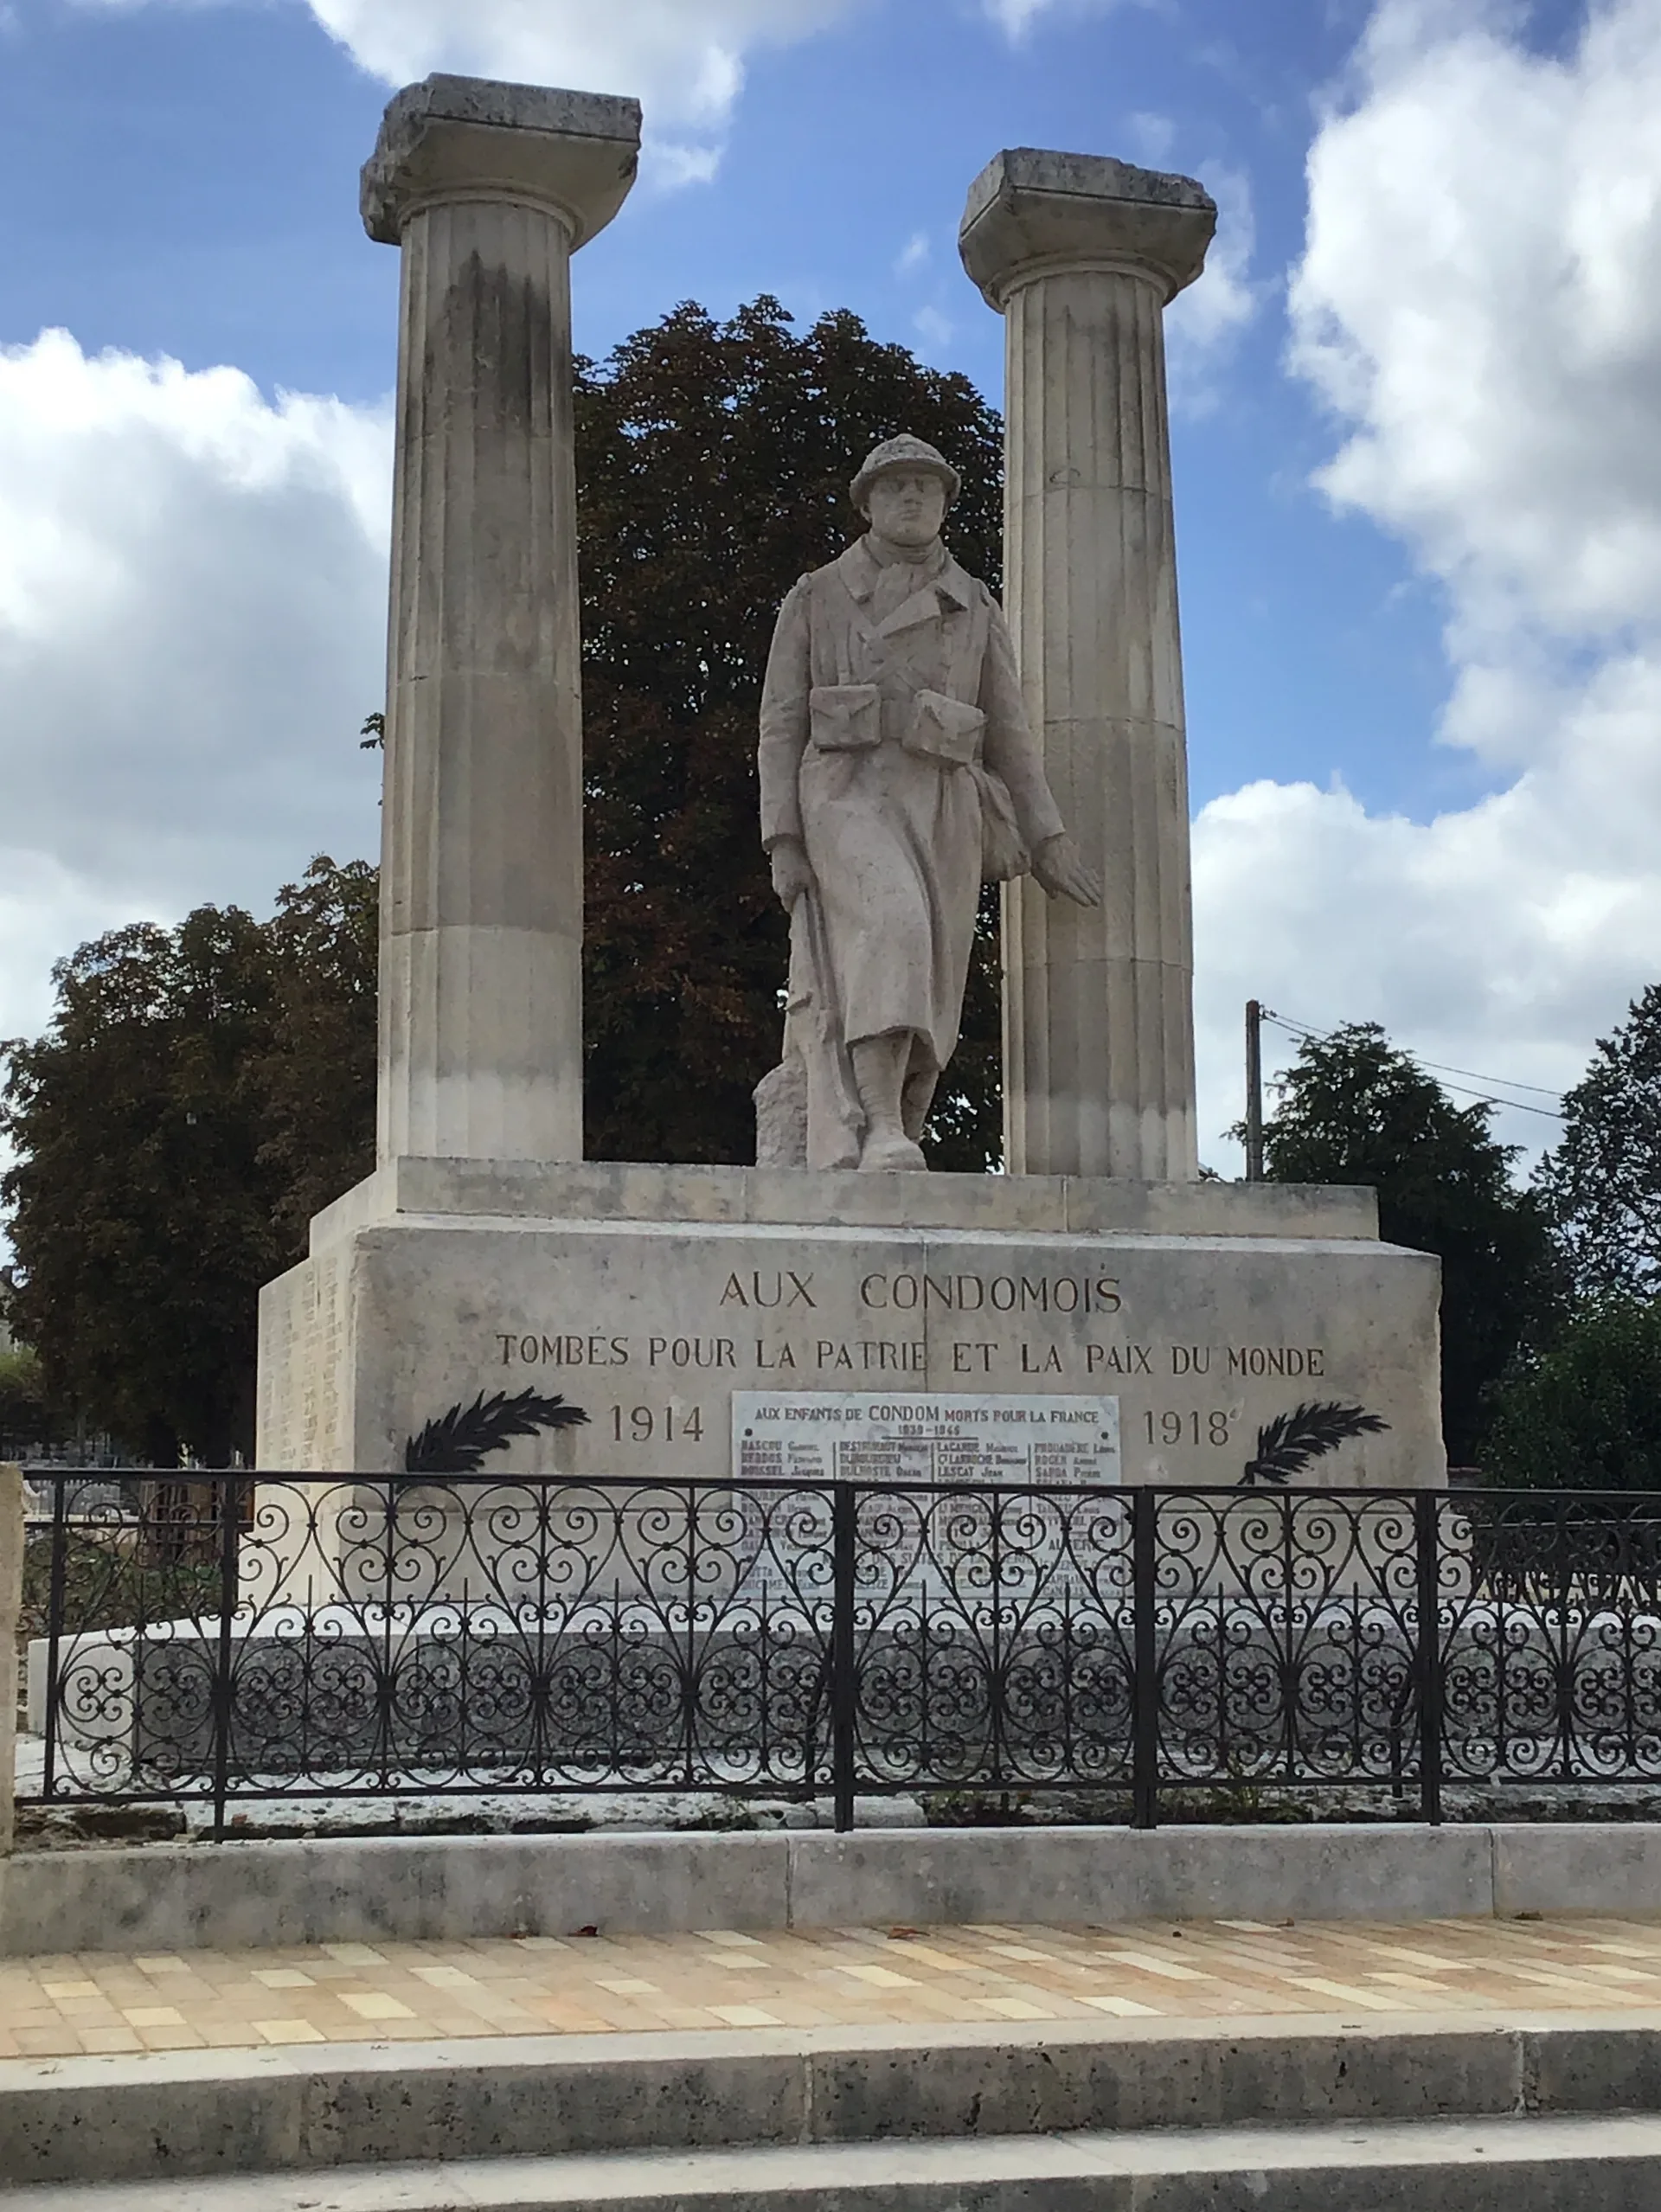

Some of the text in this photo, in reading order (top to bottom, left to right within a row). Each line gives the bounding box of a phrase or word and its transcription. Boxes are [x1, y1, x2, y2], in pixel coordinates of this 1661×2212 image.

[719, 1271, 1122, 1313] AUX CONDOMOIS
[649, 1337, 736, 1368] POUR
[756, 1339, 795, 1369] LA
[817, 1341, 927, 1370] PATRIE
[952, 1343, 998, 1372] ET
[1022, 1343, 1062, 1373] LA
[1086, 1344, 1152, 1375] PAIX
[1170, 1346, 1209, 1375] DU
[1227, 1347, 1324, 1377] MONDE
[609, 1405, 703, 1443] 1914
[754, 1405, 1100, 1424] AUX ENFANTS DE CONDOM MORTS POUR LA FRANCE
[1142, 1410, 1228, 1446] 1918
